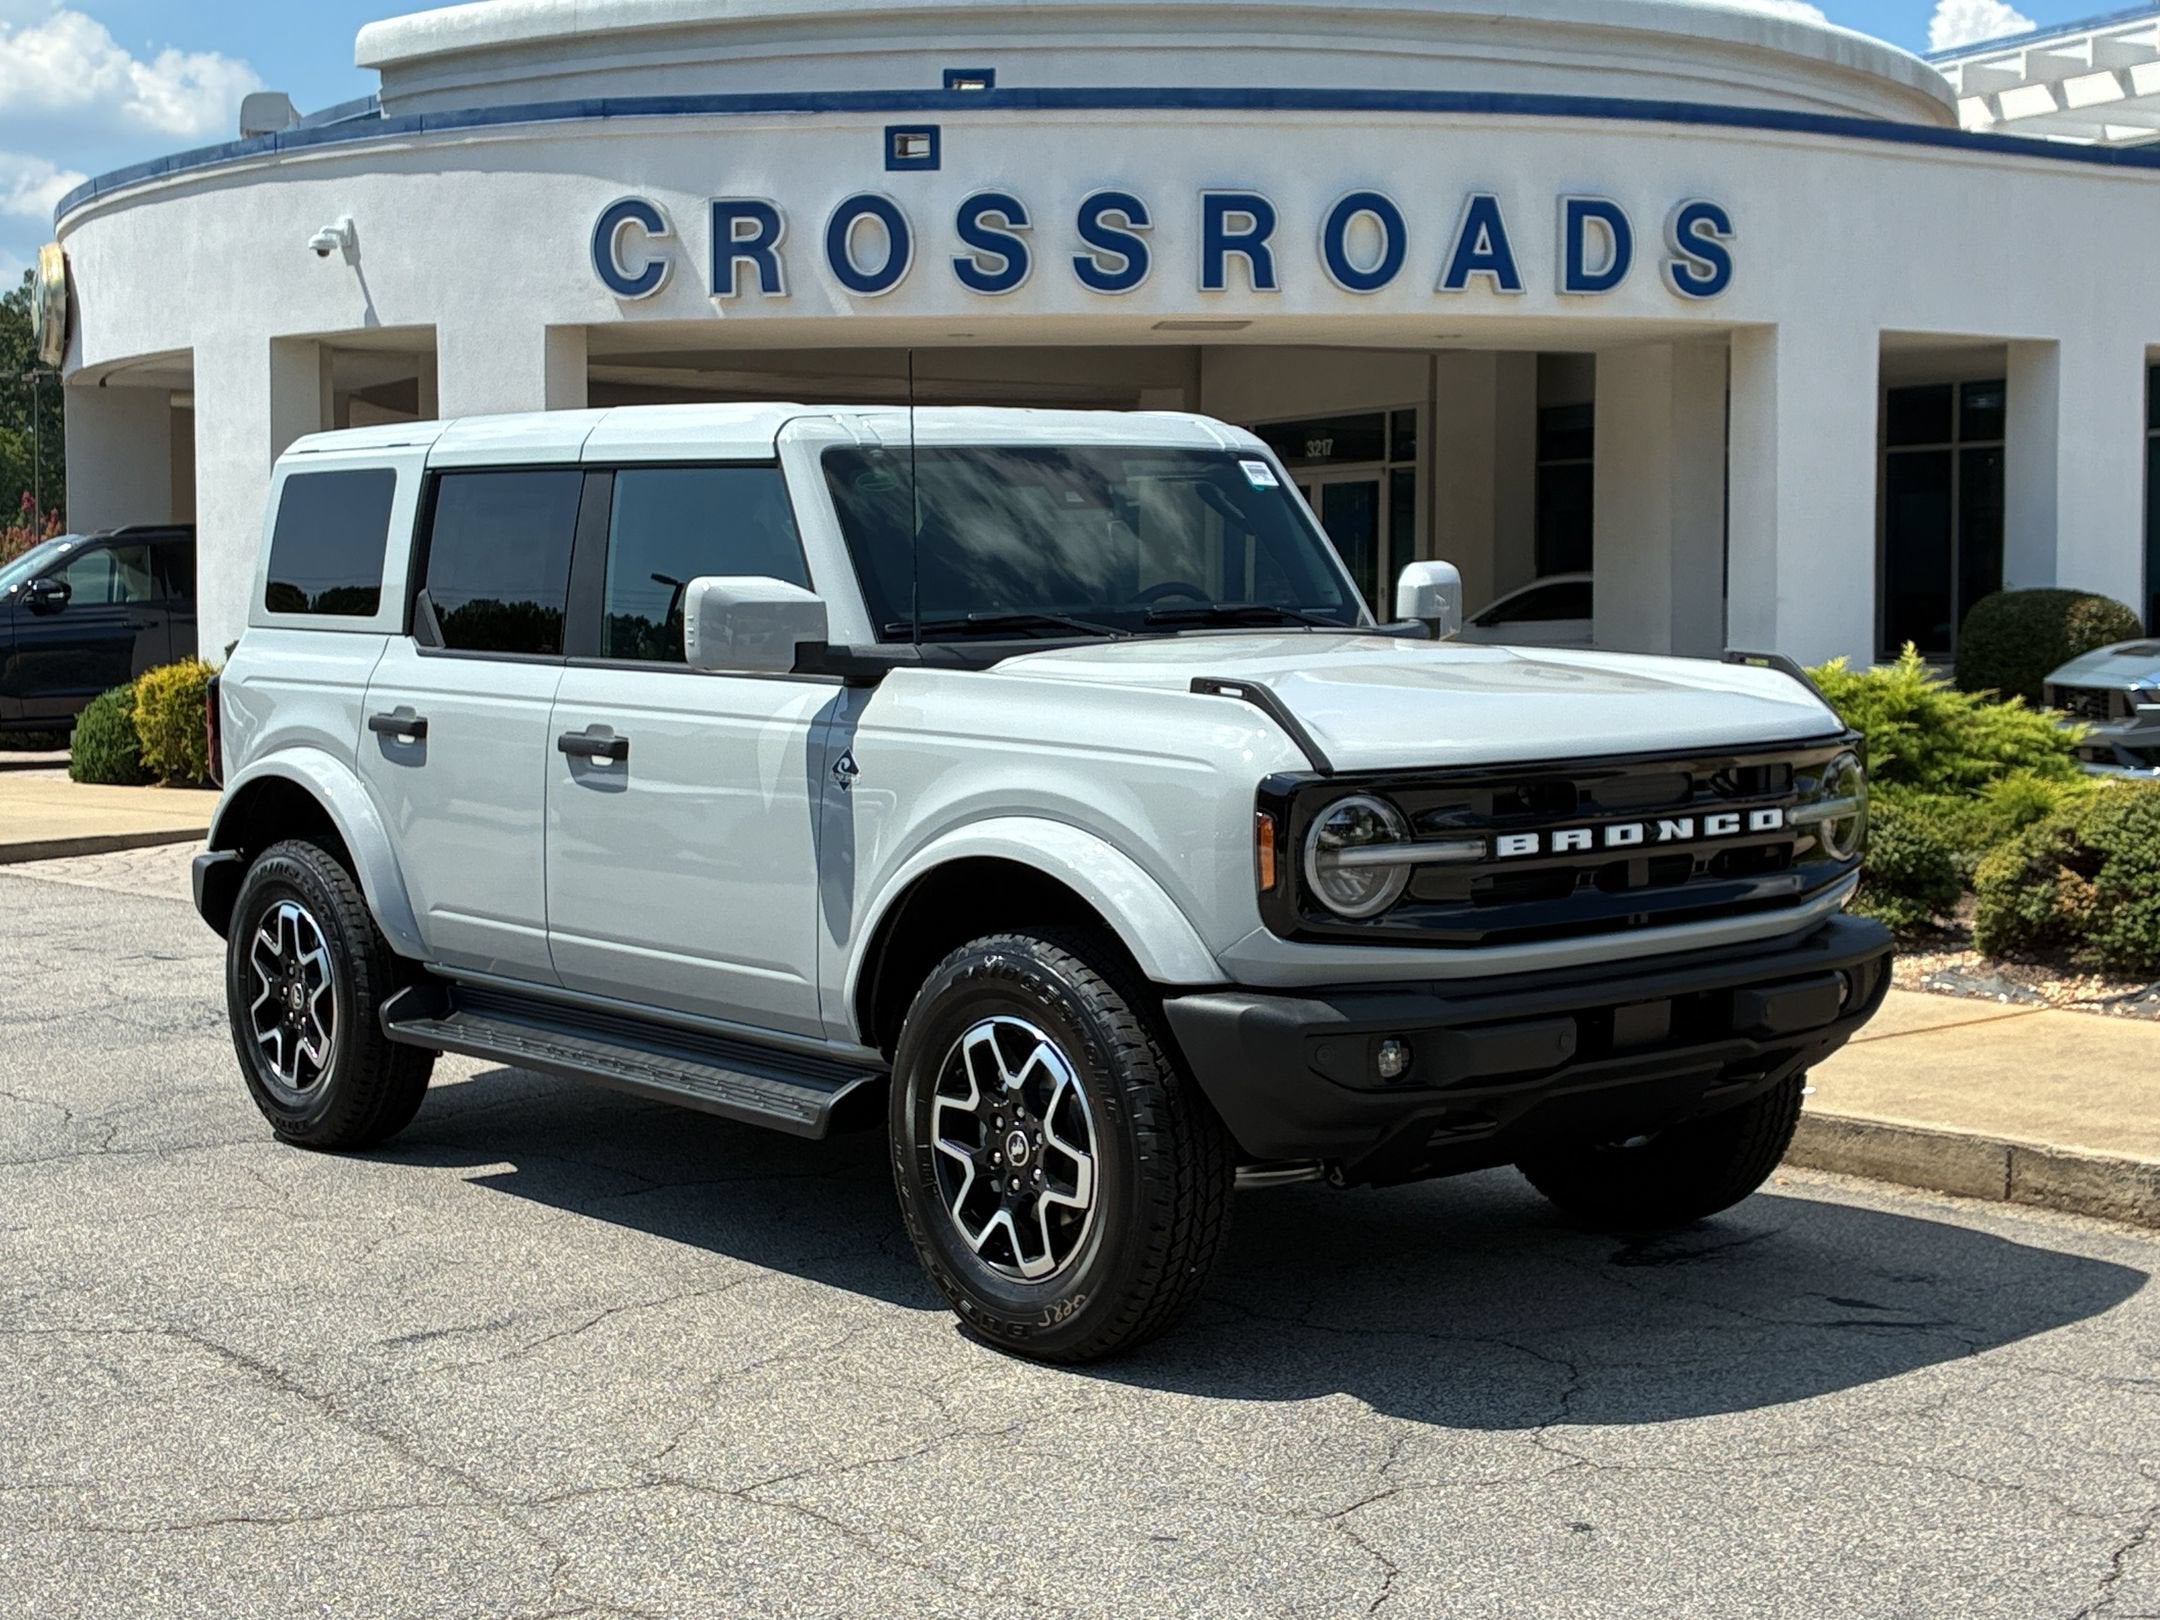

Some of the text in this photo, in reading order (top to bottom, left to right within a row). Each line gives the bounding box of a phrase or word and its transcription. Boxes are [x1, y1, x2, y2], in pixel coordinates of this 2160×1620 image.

[590, 187, 1736, 301] CROSSROADS
[1305, 438, 1334, 457] 3217
[1496, 808, 1783, 857] BRONCO
